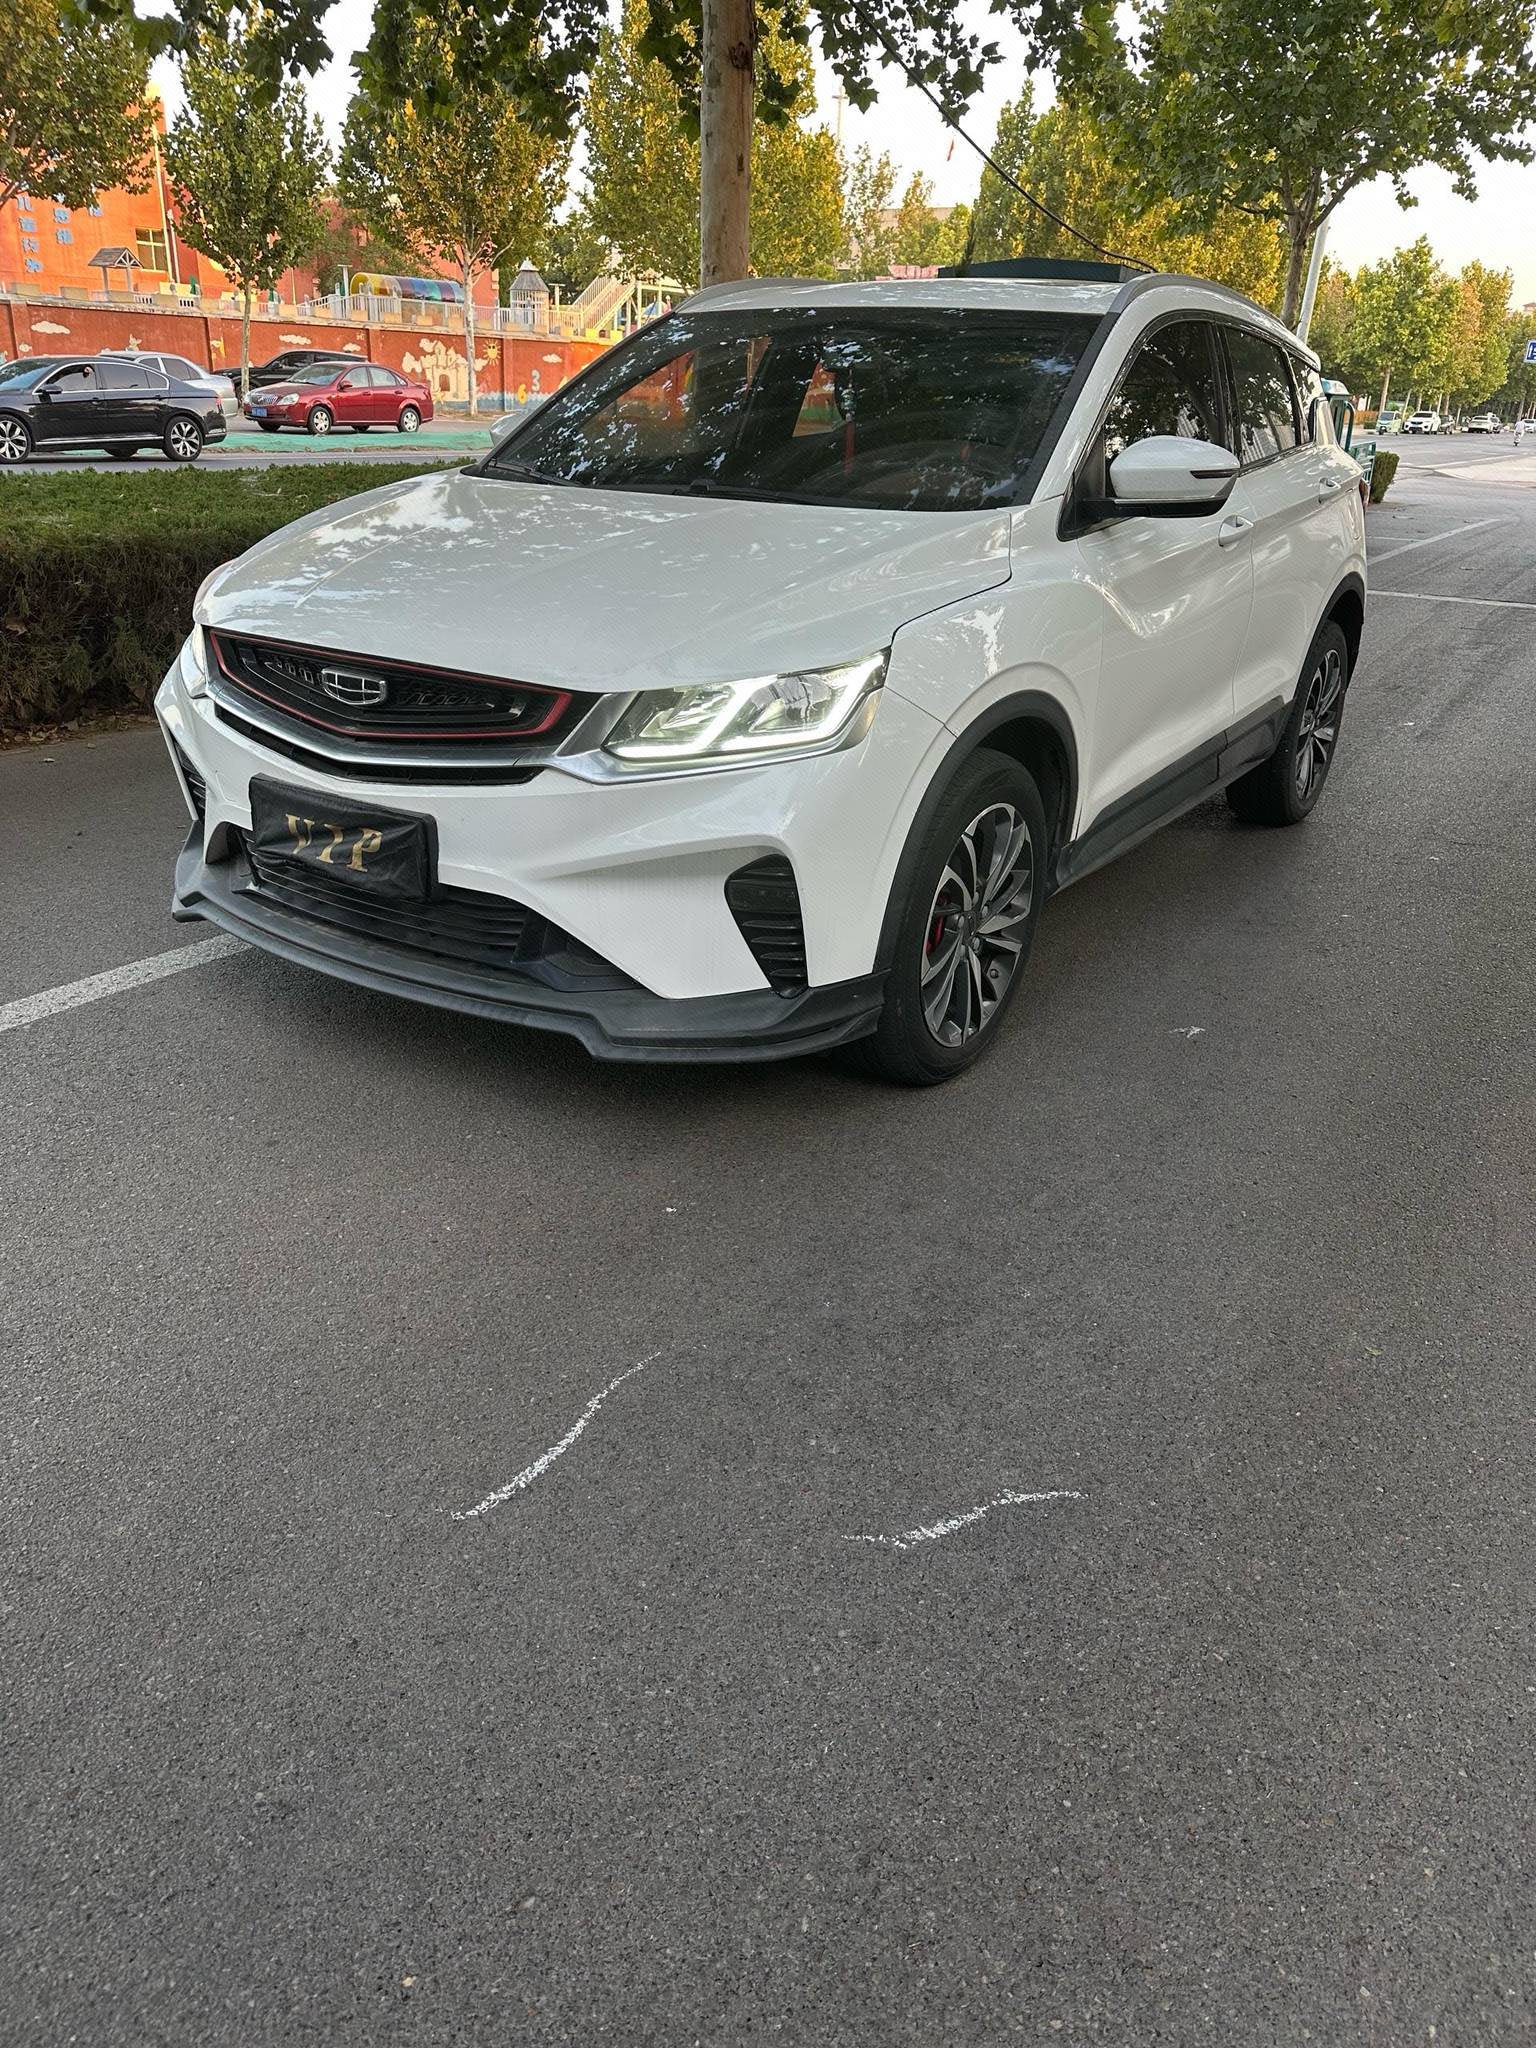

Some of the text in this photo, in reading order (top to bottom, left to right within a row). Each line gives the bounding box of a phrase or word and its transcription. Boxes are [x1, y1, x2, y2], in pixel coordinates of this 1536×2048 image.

[531, 369, 540, 392] 3
[517, 384, 527, 405] 6
[285, 813, 383, 873] VIP
